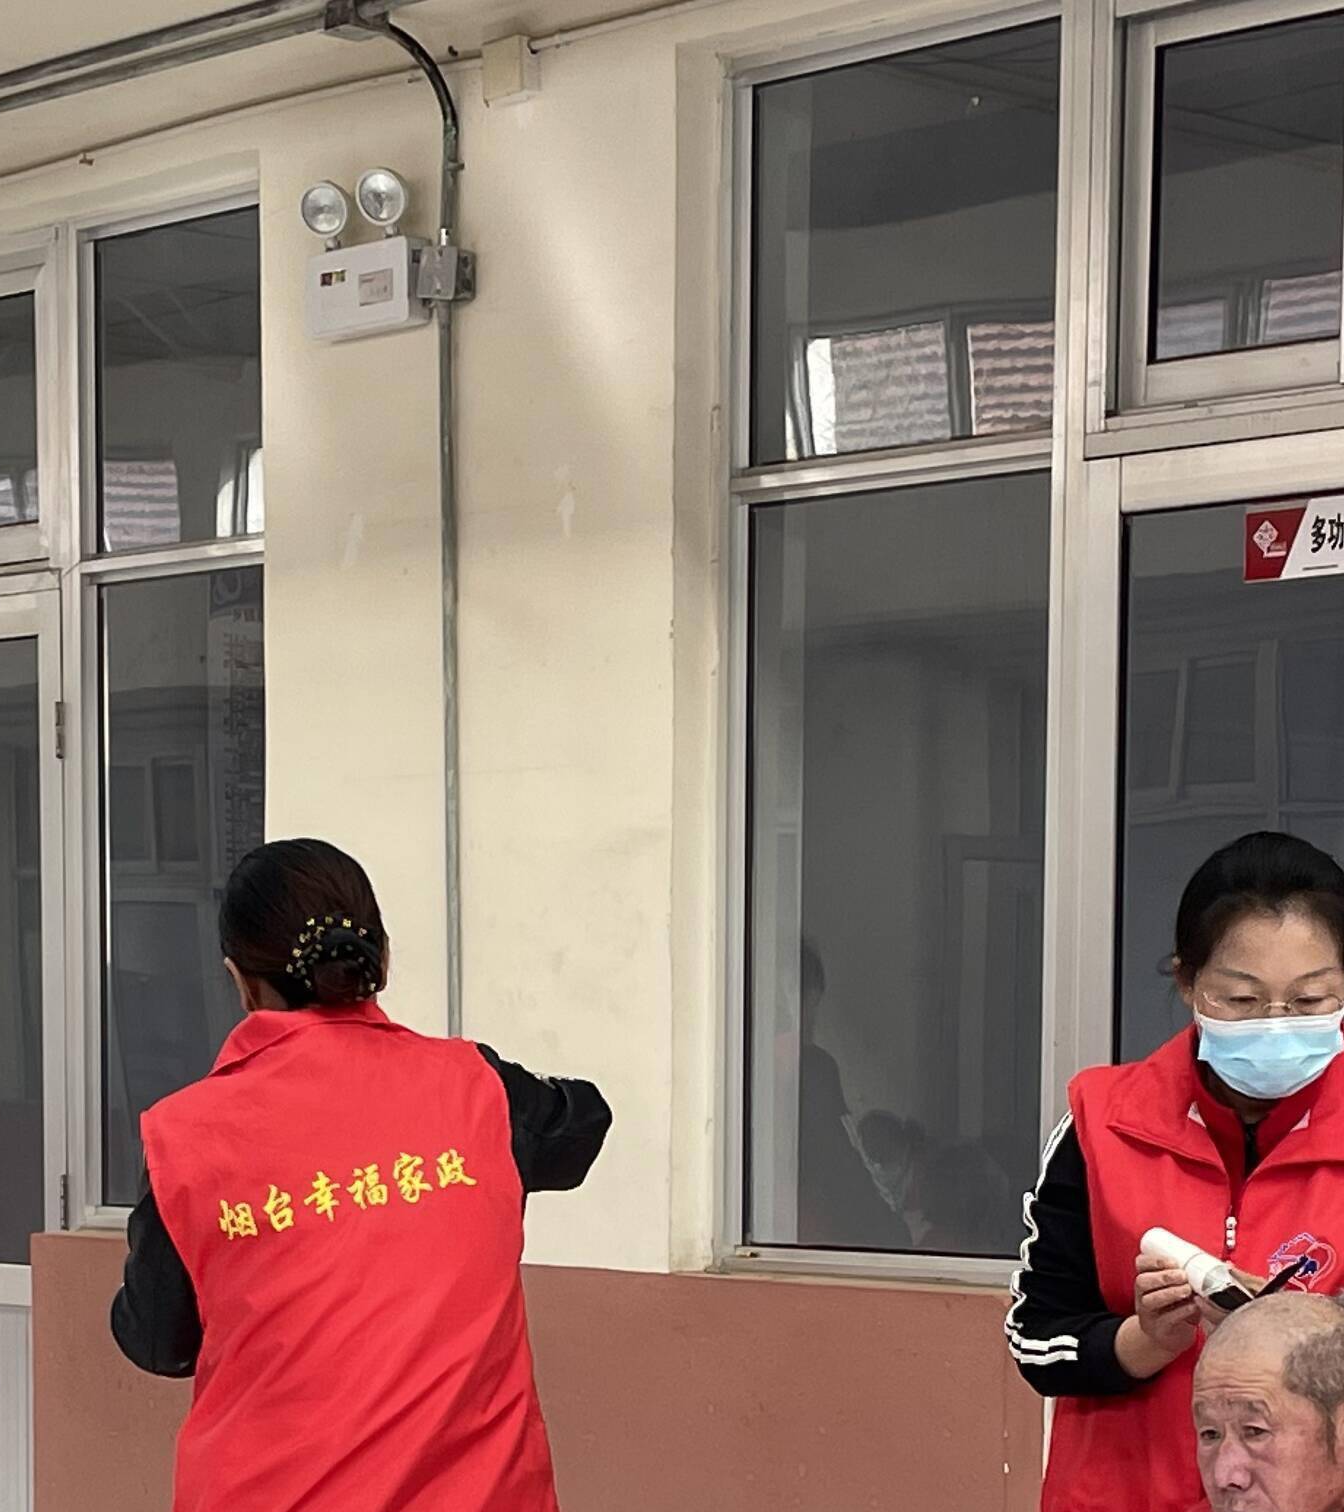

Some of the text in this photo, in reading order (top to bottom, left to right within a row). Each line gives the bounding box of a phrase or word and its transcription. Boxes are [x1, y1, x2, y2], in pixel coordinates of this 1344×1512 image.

[217, 1148, 478, 1241] 烟台幸福家政
